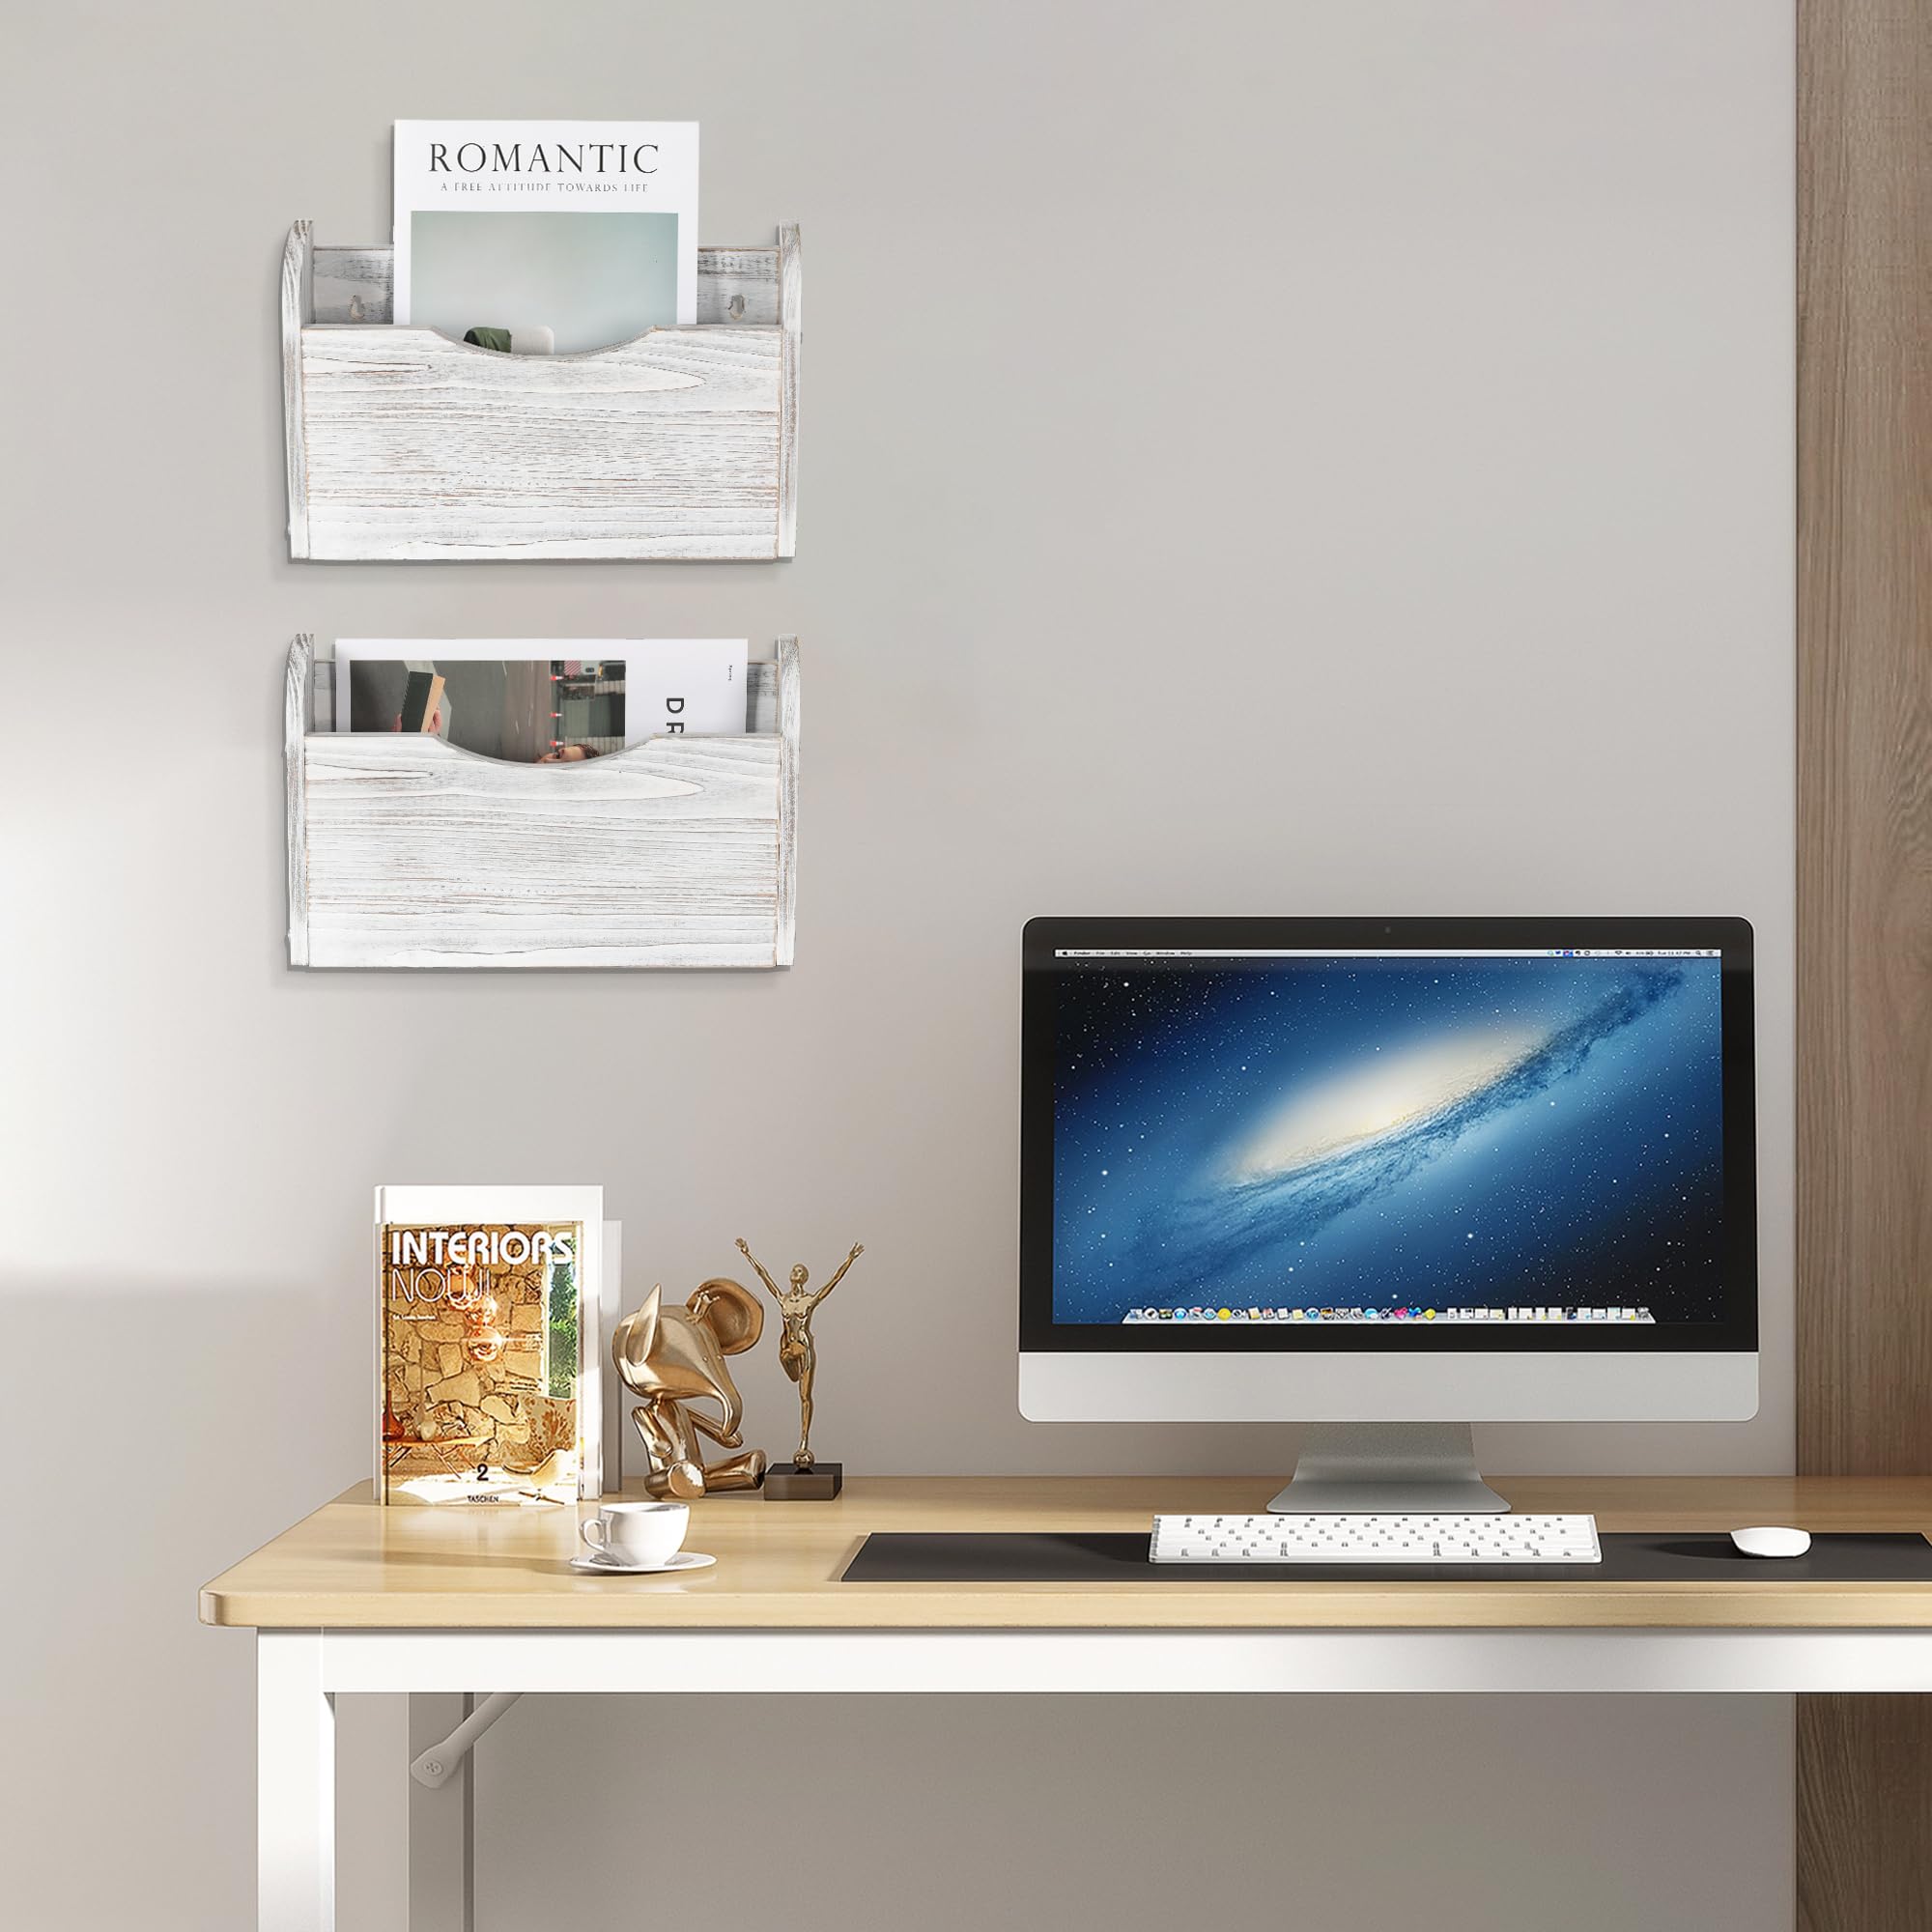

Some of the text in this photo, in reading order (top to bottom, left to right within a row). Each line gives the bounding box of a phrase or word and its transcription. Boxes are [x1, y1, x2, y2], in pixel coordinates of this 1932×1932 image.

[428, 142, 659, 174] ROMANTIC
[440, 183, 448, 191] A
[454, 183, 482, 191] FREE
[557, 183, 618, 192] TOWARDS
[624, 184, 648, 192] LIFE
[391, 1230, 573, 1265] INTERIORS
[476, 1463, 490, 1482] 2
